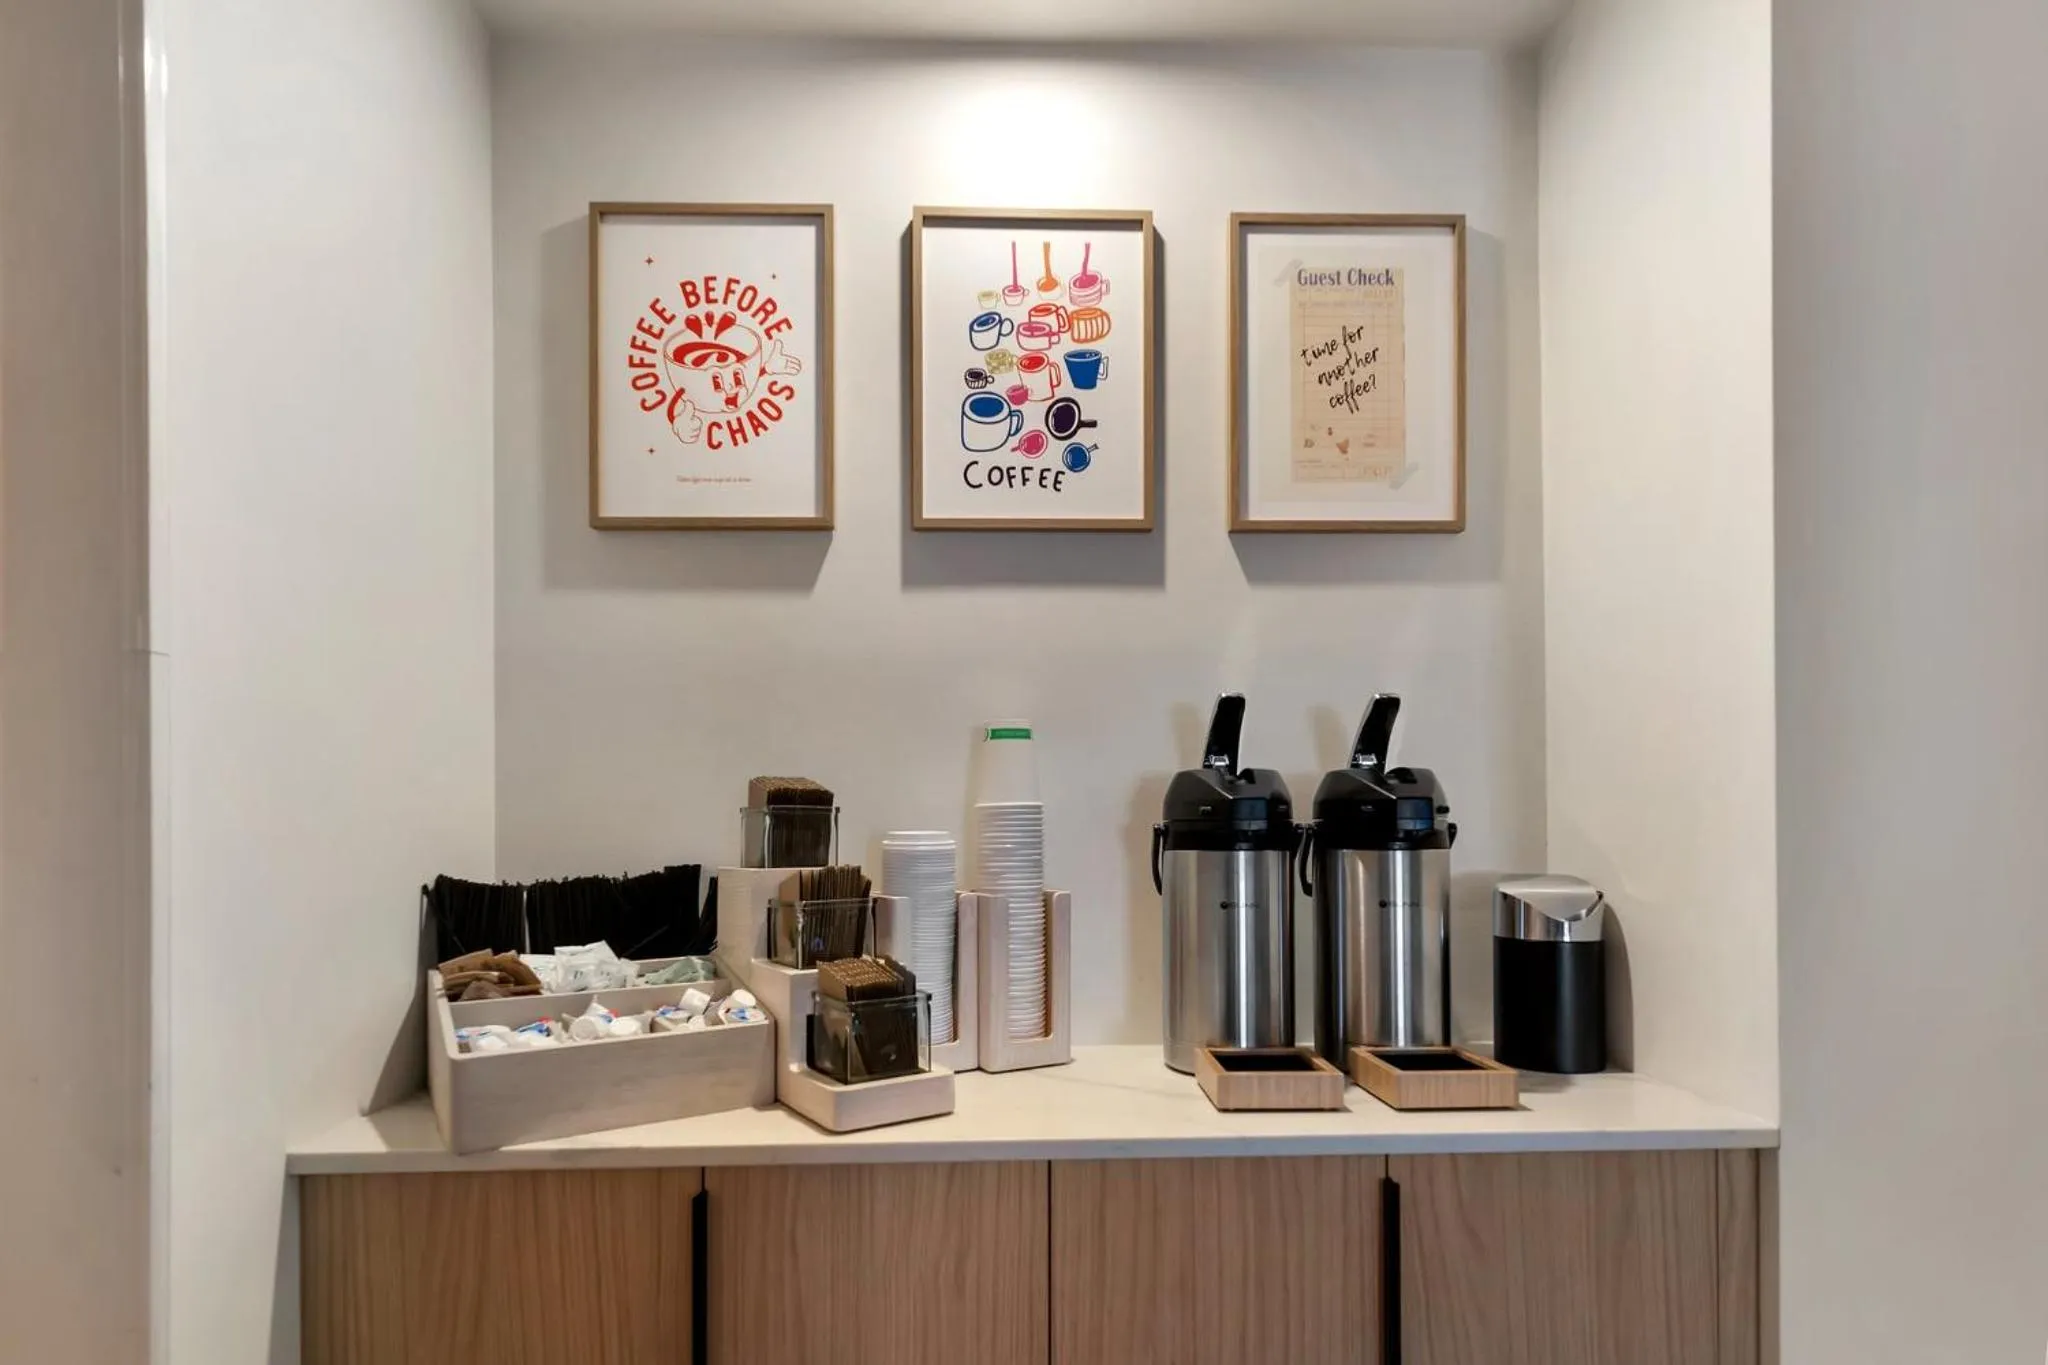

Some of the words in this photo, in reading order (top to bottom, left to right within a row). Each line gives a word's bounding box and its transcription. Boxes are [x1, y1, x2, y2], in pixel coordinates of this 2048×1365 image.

[1297, 268, 1341, 287] Guest
[1347, 267, 1395, 287] Check
[627, 298, 676, 413] COFFEE
[679, 275, 793, 341] BEFORE
[1300, 339, 1339, 367] time
[1342, 325, 1364, 359] for
[1317, 347, 1379, 387] another
[706, 380, 795, 450] CHAOS
[1329, 373, 1377, 415] coffee?
[963, 460, 1066, 493] COFFEE
